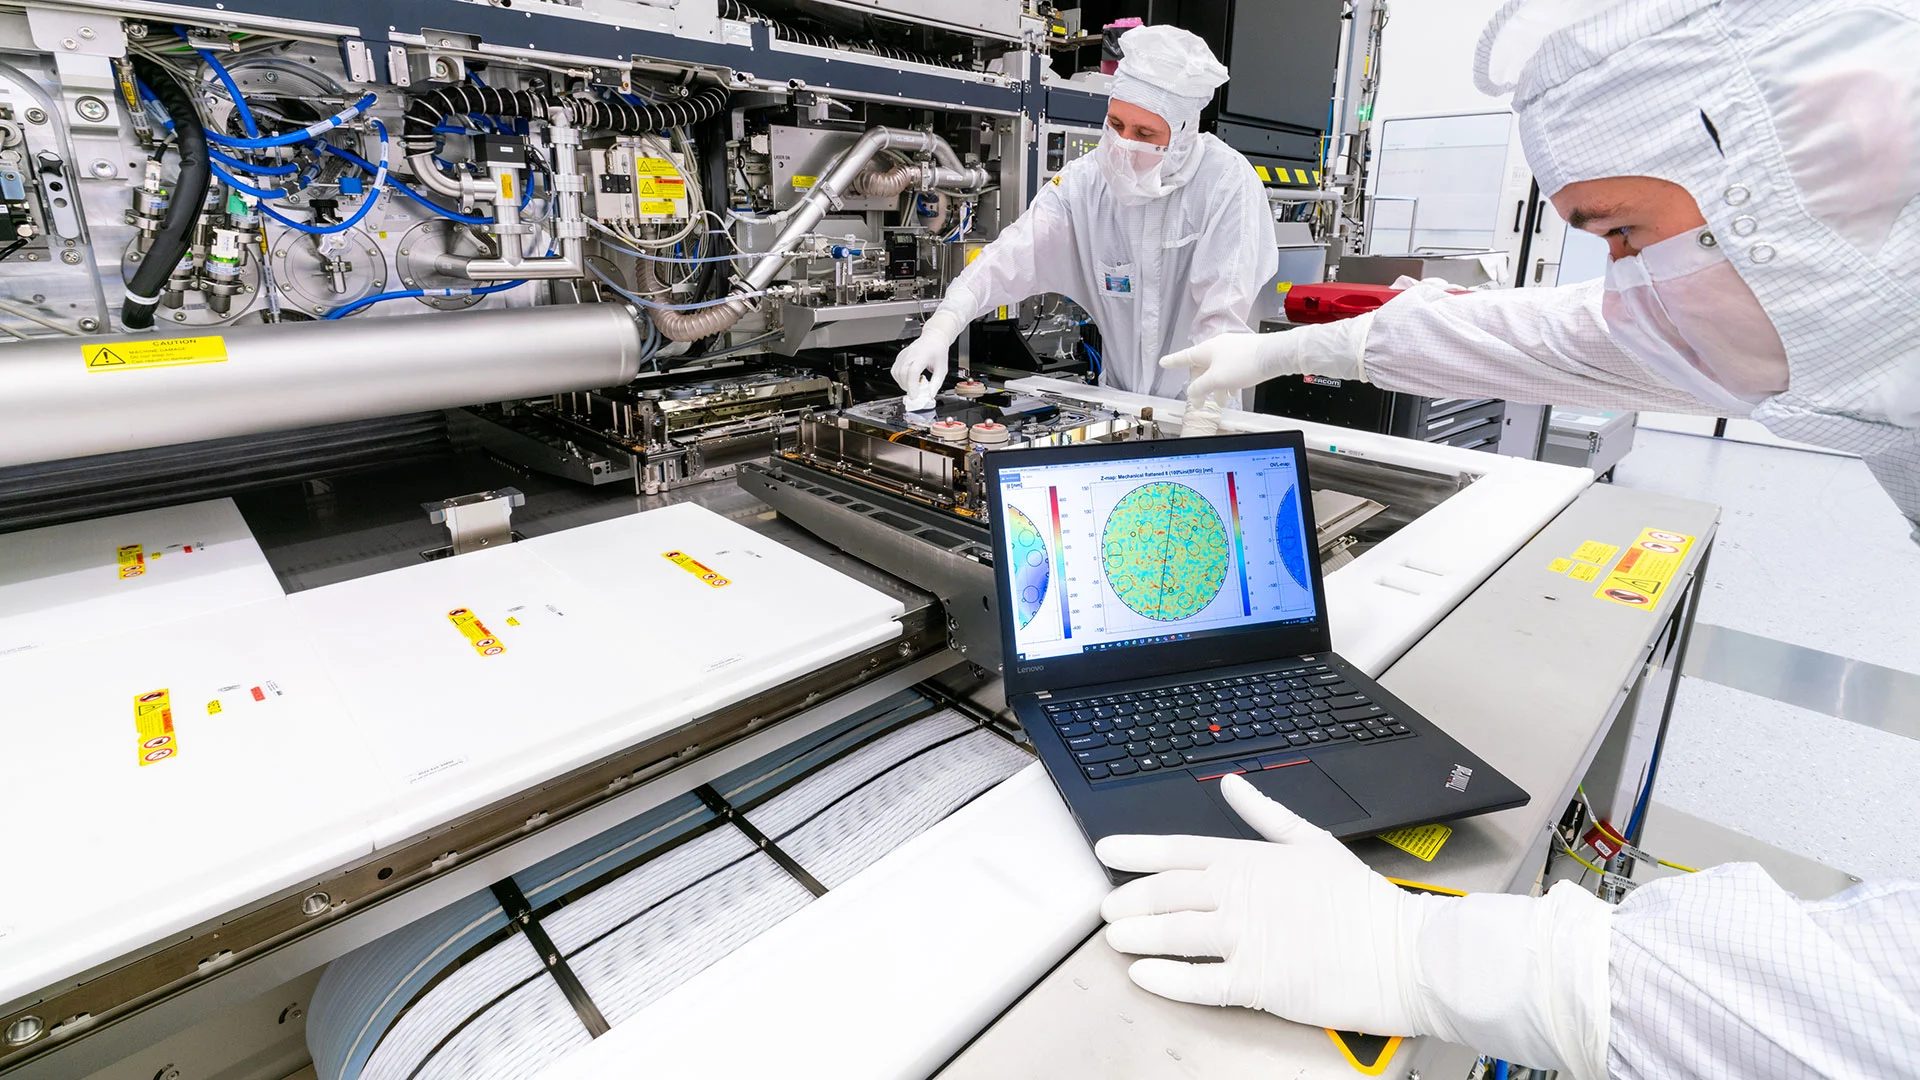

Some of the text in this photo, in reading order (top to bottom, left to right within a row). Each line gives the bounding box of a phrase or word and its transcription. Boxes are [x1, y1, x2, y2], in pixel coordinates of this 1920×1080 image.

[1024, 84, 1032, 93] 51
[152, 339, 197, 347] CAUTION
[1016, 665, 1045, 674] Lenovo
